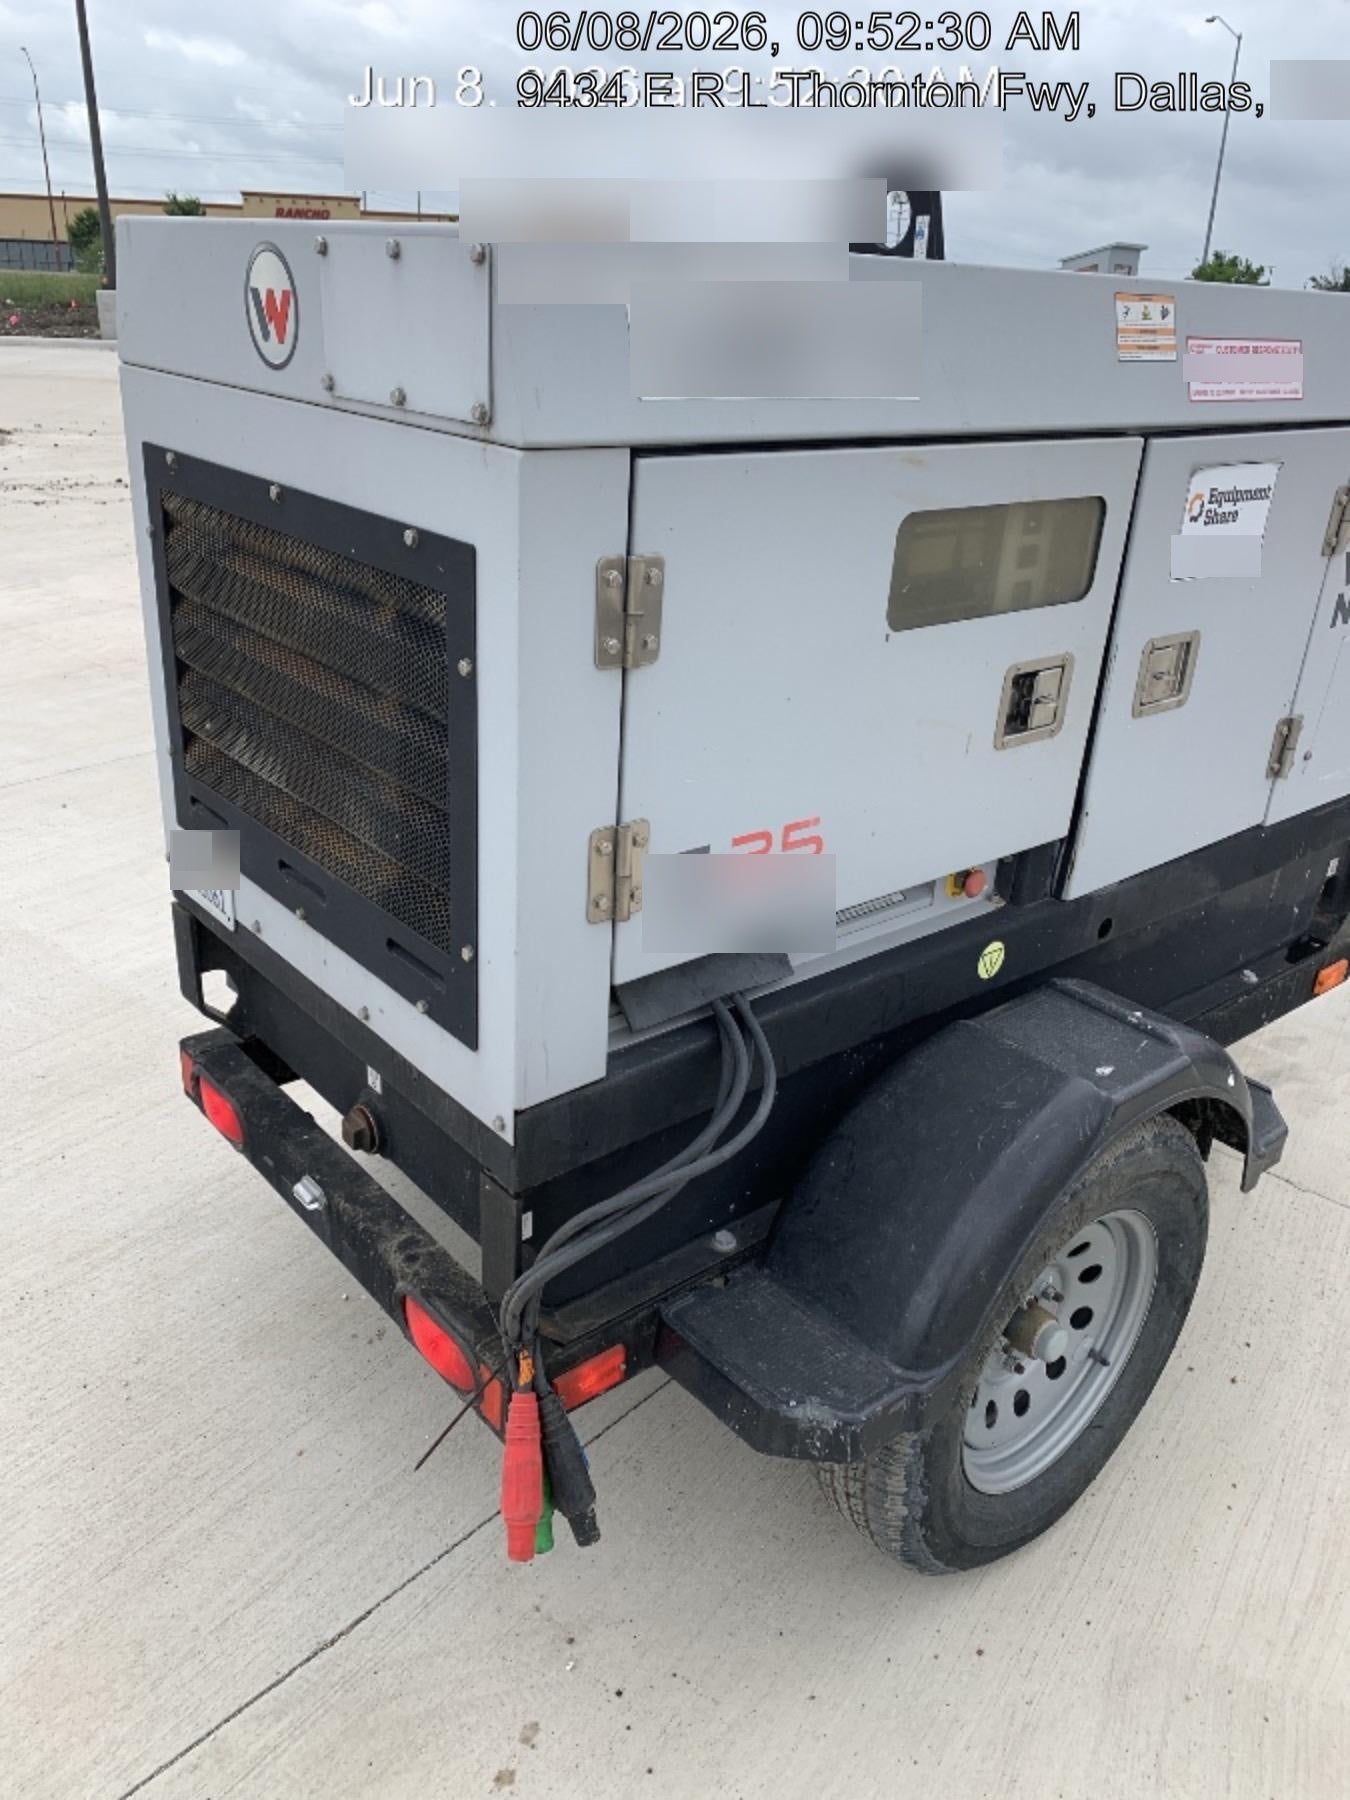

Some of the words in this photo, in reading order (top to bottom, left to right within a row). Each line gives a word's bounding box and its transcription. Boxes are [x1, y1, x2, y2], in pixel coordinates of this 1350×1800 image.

[275, 207, 331, 220] RANCHO
[1207, 484, 1272, 508] Equipment
[1203, 508, 1239, 527] Share
